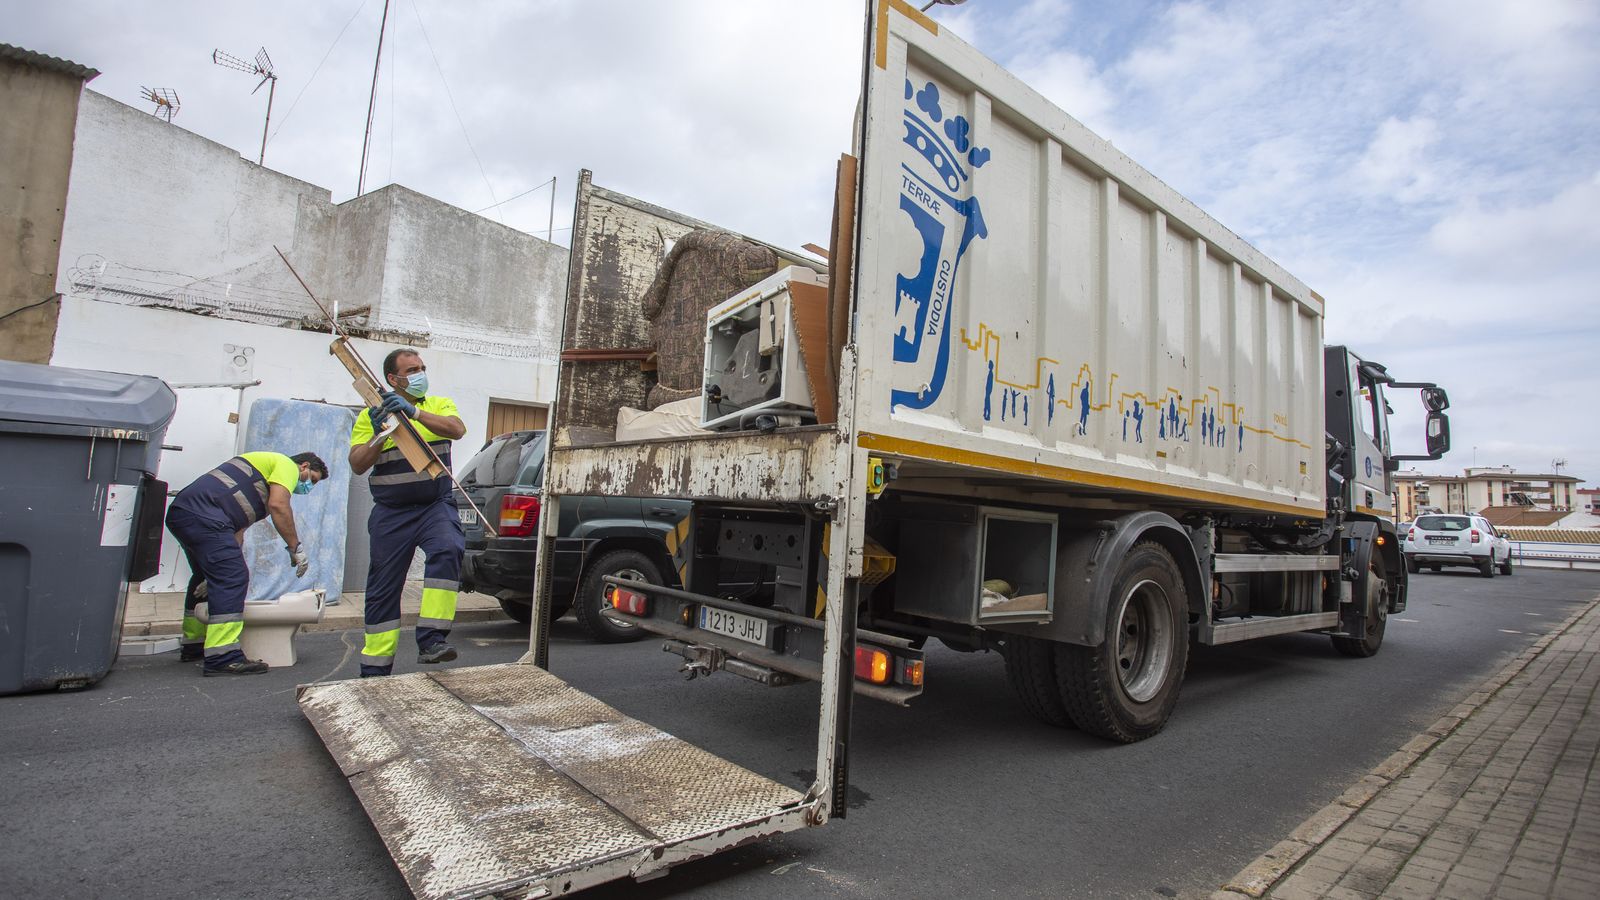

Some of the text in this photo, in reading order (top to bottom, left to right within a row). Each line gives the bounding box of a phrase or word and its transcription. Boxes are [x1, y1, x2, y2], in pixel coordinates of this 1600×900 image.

[902, 174, 941, 215] TERRÆ
[927, 260, 951, 336] CUSTODIA
[709, 610, 763, 641] 1213 JHJ
